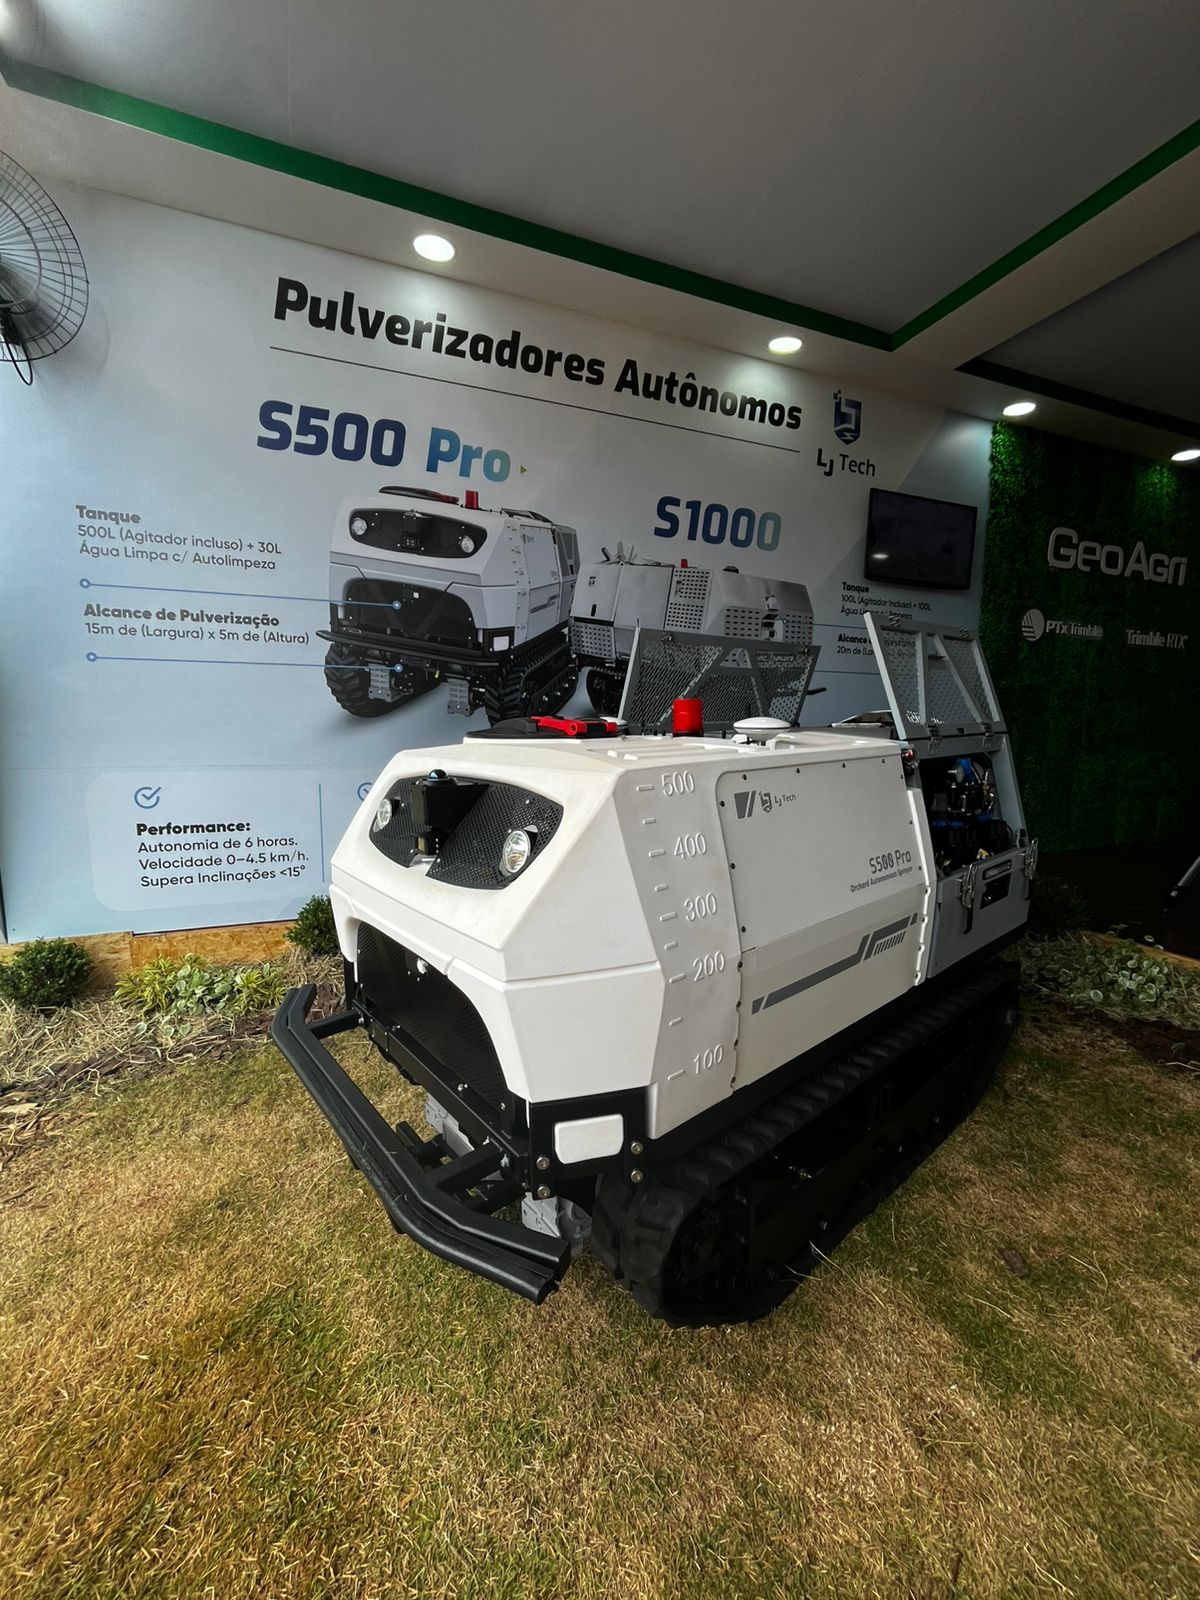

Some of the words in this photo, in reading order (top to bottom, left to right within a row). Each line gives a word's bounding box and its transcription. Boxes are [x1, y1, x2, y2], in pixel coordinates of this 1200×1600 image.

[274, 277, 605, 386] Pulverizadores
[614, 359, 802, 430] Autônomos
[257, 400, 406, 467] S500
[425, 427, 511, 482] Pro
[839, 453, 876, 477] Tech
[76, 504, 141, 524] Tanque
[653, 496, 782, 552] S1000
[78, 525, 115, 539] 500L
[120, 527, 187, 546] (Agitador
[192, 535, 242, 551] incluso)
[258, 541, 282, 554] 30L
[79, 540, 120, 558] Água
[124, 546, 168, 562] Limpa
[172, 550, 188, 564] c/
[192, 552, 276, 570] Autolimpeza
[842, 582, 869, 593] Tanque
[84, 603, 152, 620] Alcance
[156, 608, 176, 621] de
[180, 609, 280, 629] Pulverização
[840, 604, 858, 616] Água
[85, 622, 114, 635] 15m
[118, 623, 137, 636] de
[141, 624, 204, 641] (Largura)
[208, 631, 216, 640] x
[219, 629, 239, 641] 5m
[243, 629, 260, 642] de
[264, 631, 309, 645] (Altura)
[837, 634, 867, 643] Alcance
[1070, 622, 1103, 637] Trimble
[1126, 630, 1165, 647] Trimble
[661, 770, 695, 797] 500
[782, 794, 797, 802] Tech
[136, 822, 251, 836] Performance:
[137, 839, 219, 853] Autonomia
[223, 838, 241, 850] de
[245, 837, 253, 848] 6
[256, 835, 298, 848] horas.
[673, 832, 706, 860] 400
[139, 855, 223, 870] Velocidade
[270, 850, 309, 863] km/h.
[869, 852, 894, 874] S500
[894, 849, 912, 867] Pro
[141, 874, 194, 889] Supera
[198, 869, 276, 884] Inclinações
[279, 865, 306, 878] <15°
[684, 892, 718, 922] 300
[693, 951, 726, 983] 200
[693, 1043, 724, 1075] 100
